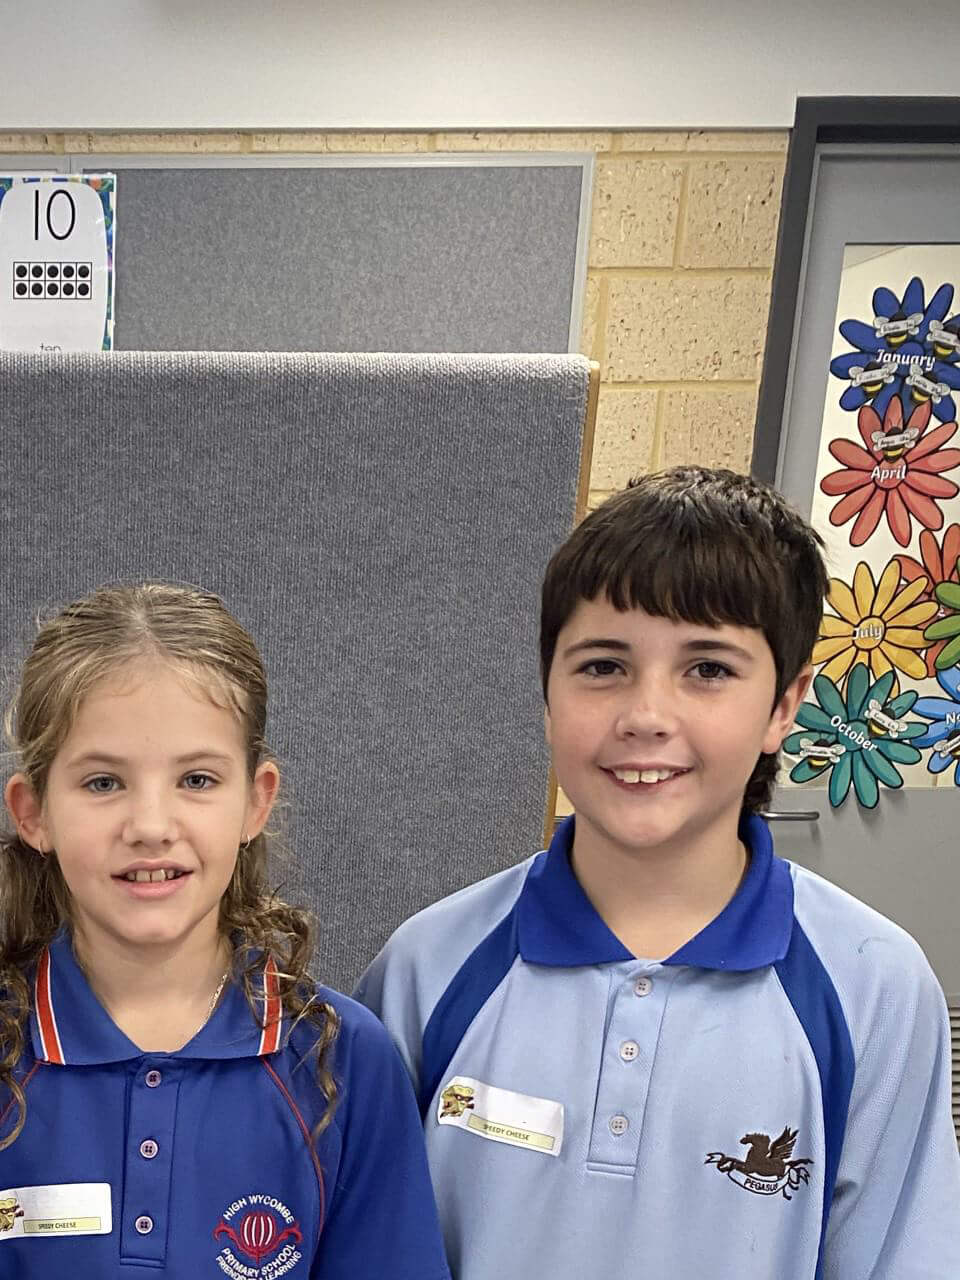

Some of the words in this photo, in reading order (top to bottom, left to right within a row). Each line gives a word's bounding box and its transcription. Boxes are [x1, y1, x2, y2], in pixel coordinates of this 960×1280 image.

[34, 189, 76, 241] 10
[876, 349, 936, 371] January
[871, 465, 907, 483] April
[853, 623, 882, 640] July
[830, 715, 878, 752] October
[223, 1197, 247, 1220] HIGH
[249, 1194, 294, 1224] WYCOMBE
[221, 1247, 259, 1277] PRIMARY
[261, 1244, 296, 1275] SCHOOL
